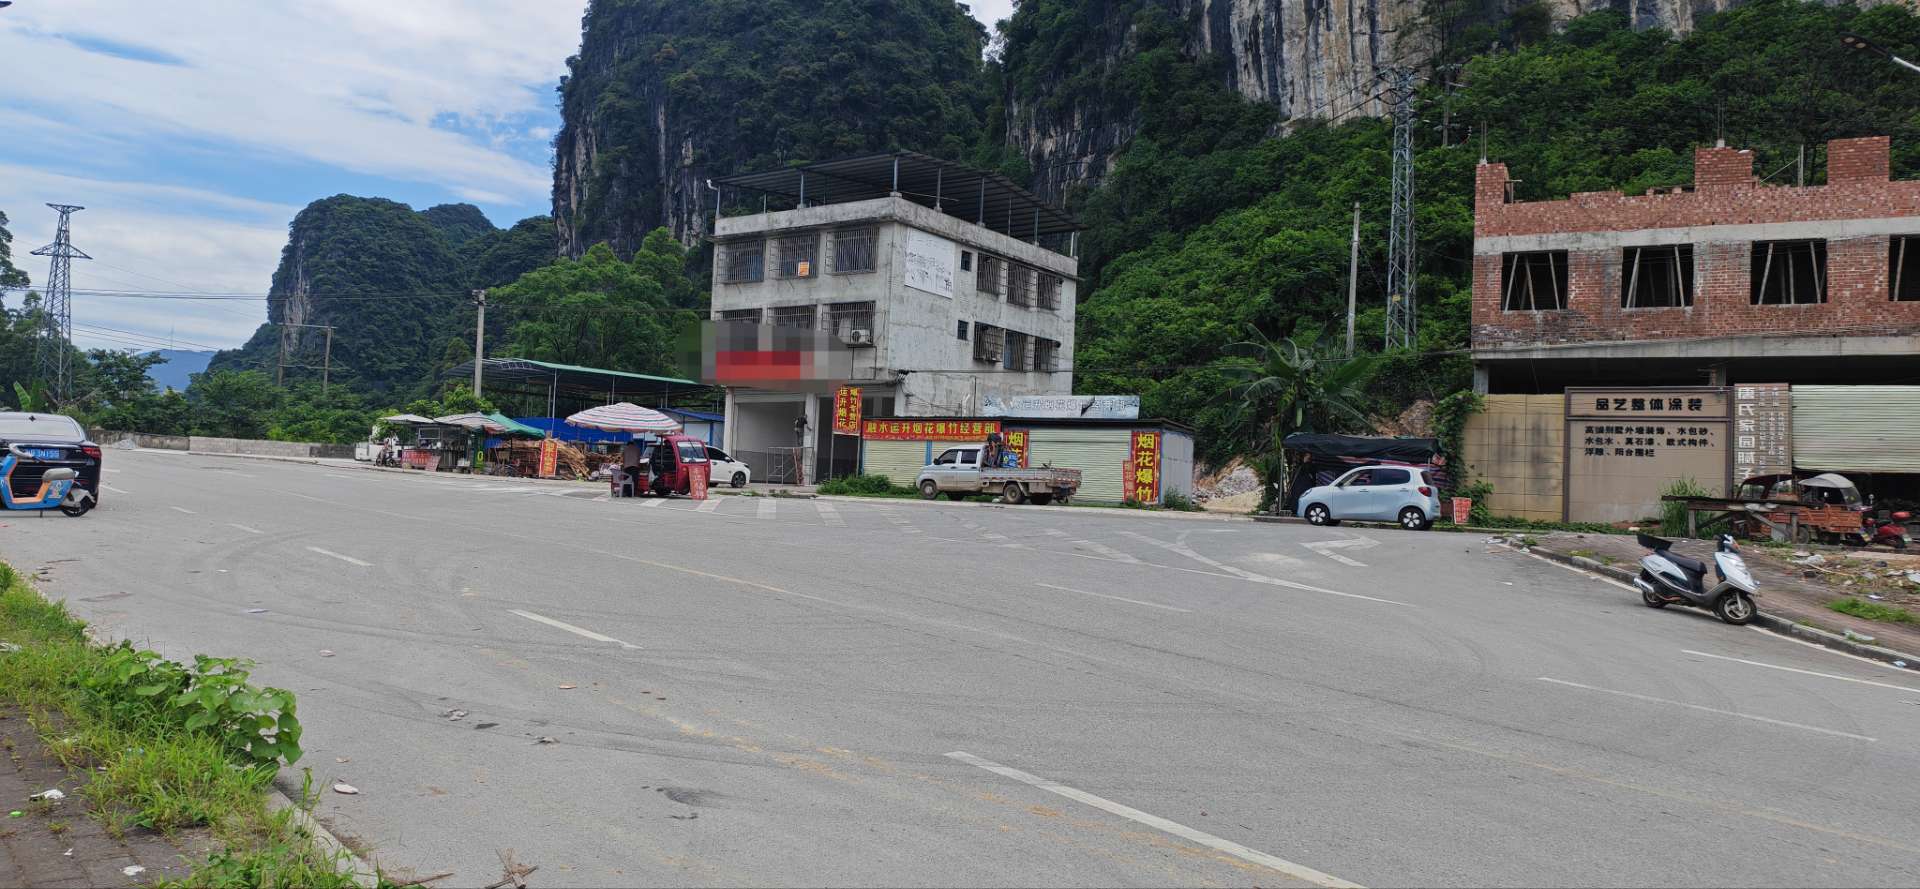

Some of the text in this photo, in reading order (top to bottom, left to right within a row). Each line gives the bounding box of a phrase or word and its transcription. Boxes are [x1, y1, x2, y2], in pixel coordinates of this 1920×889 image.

[1595, 398, 1703, 411] 品艺整体涂装
[1136, 432, 1155, 501] 烟花爆竹
